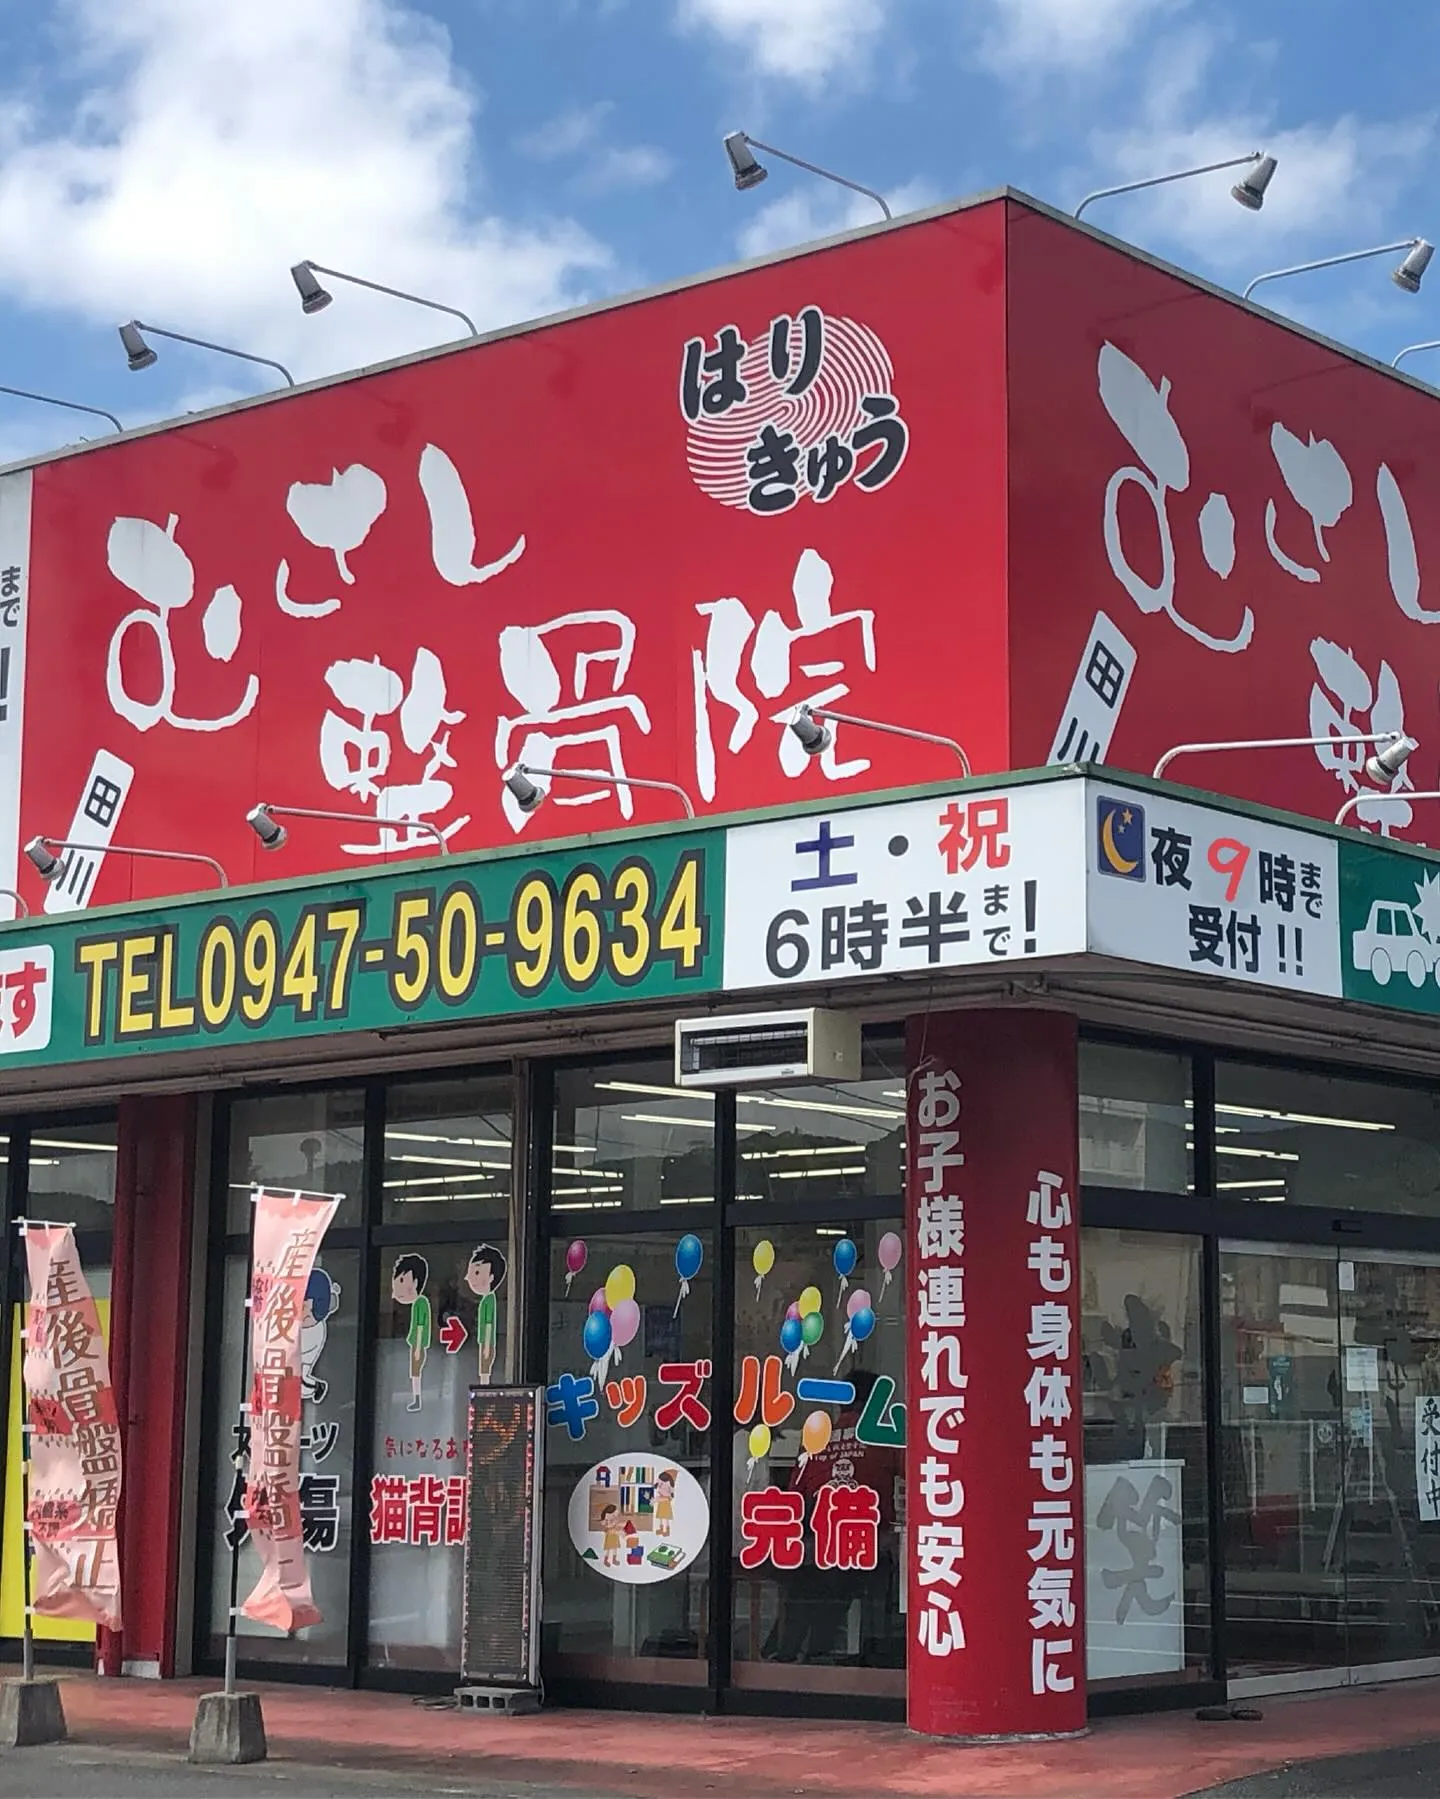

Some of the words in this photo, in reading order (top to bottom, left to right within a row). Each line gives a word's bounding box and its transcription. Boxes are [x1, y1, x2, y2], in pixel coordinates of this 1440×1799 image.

[681, 305, 823, 420] はり
[746, 393, 909, 516] きゅう
[1098, 340, 1440, 652] むさし
[106, 443, 526, 732] むさし
[317, 548, 876, 857] 整骨院
[55, 774, 122, 907] 田川
[790, 796, 1012, 893] 土・祝
[0, 961, 47, 1039] す
[262, 1230, 317, 1590] 産後骨盤矯
[917, 1070, 968, 1659] お子様連れでも安心
[230, 1423, 339, 1463] スツ
[384, 1436, 468, 1459] 気になるあ
[1023, 1169, 1077, 1696] 心も身体も元気に
[740, 1485, 880, 1571] 完備
[1097, 1474, 1182, 1625] 笑
